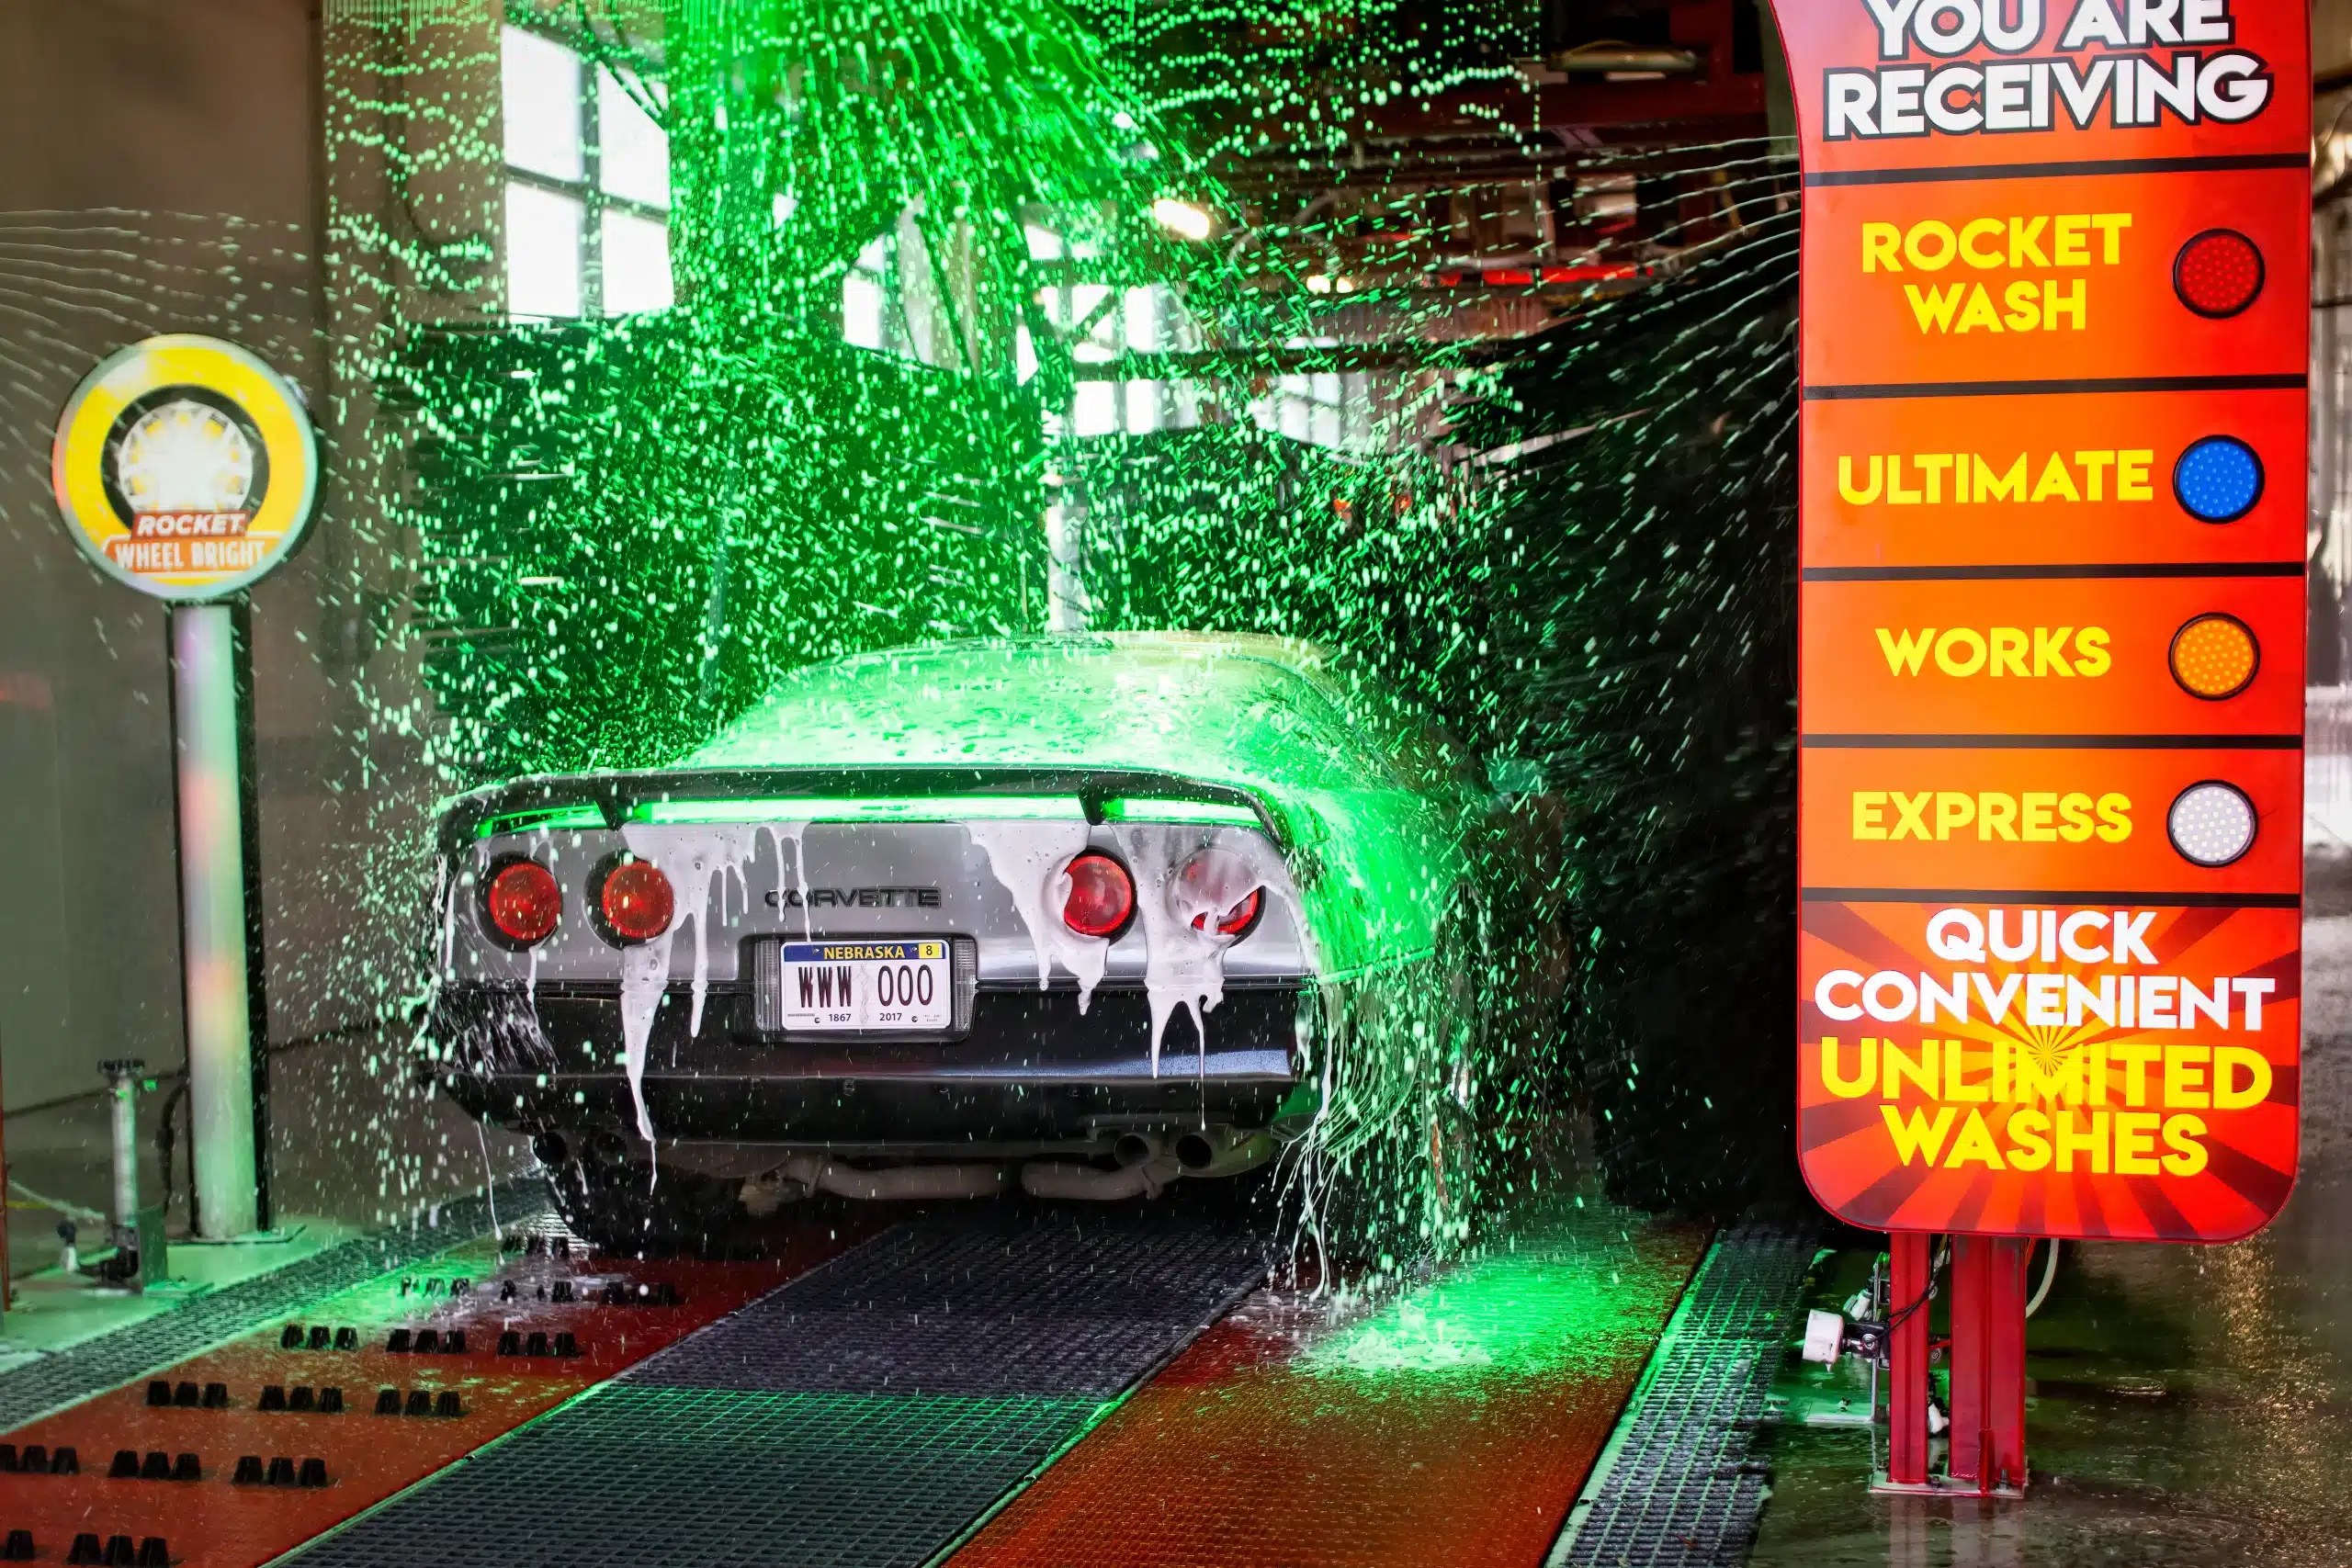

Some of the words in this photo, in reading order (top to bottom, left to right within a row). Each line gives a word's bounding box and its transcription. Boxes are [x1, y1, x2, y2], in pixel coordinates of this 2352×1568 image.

[1866, 0, 2041, 56] YOU
[2068, 0, 2229, 48] ARE
[1827, 54, 2268, 137] RECEIVING
[1861, 213, 2132, 273] ROCKET
[1904, 279, 2086, 334] WASH
[1838, 449, 2154, 505] ULTIMATE
[138, 513, 245, 536] ROCKET
[116, 543, 185, 568] WHEEL
[191, 540, 265, 568] BRIGHT
[1875, 626, 2111, 677] WORKS
[1852, 792, 2132, 842] EXPRESS
[764, 886, 941, 908] CORVETTE
[823, 946, 905, 959] NEBRASKA
[925, 944, 933, 956] 8
[1926, 908, 2157, 964] QUICK
[798, 966, 853, 1009] WWW
[1815, 970, 2276, 1031] CONVENIENT
[829, 1014, 852, 1022] 1867
[879, 1013, 902, 1021] 2017
[1821, 1037, 2273, 1110] UNLIMITED
[1880, 1105, 2208, 1176] WASHES
